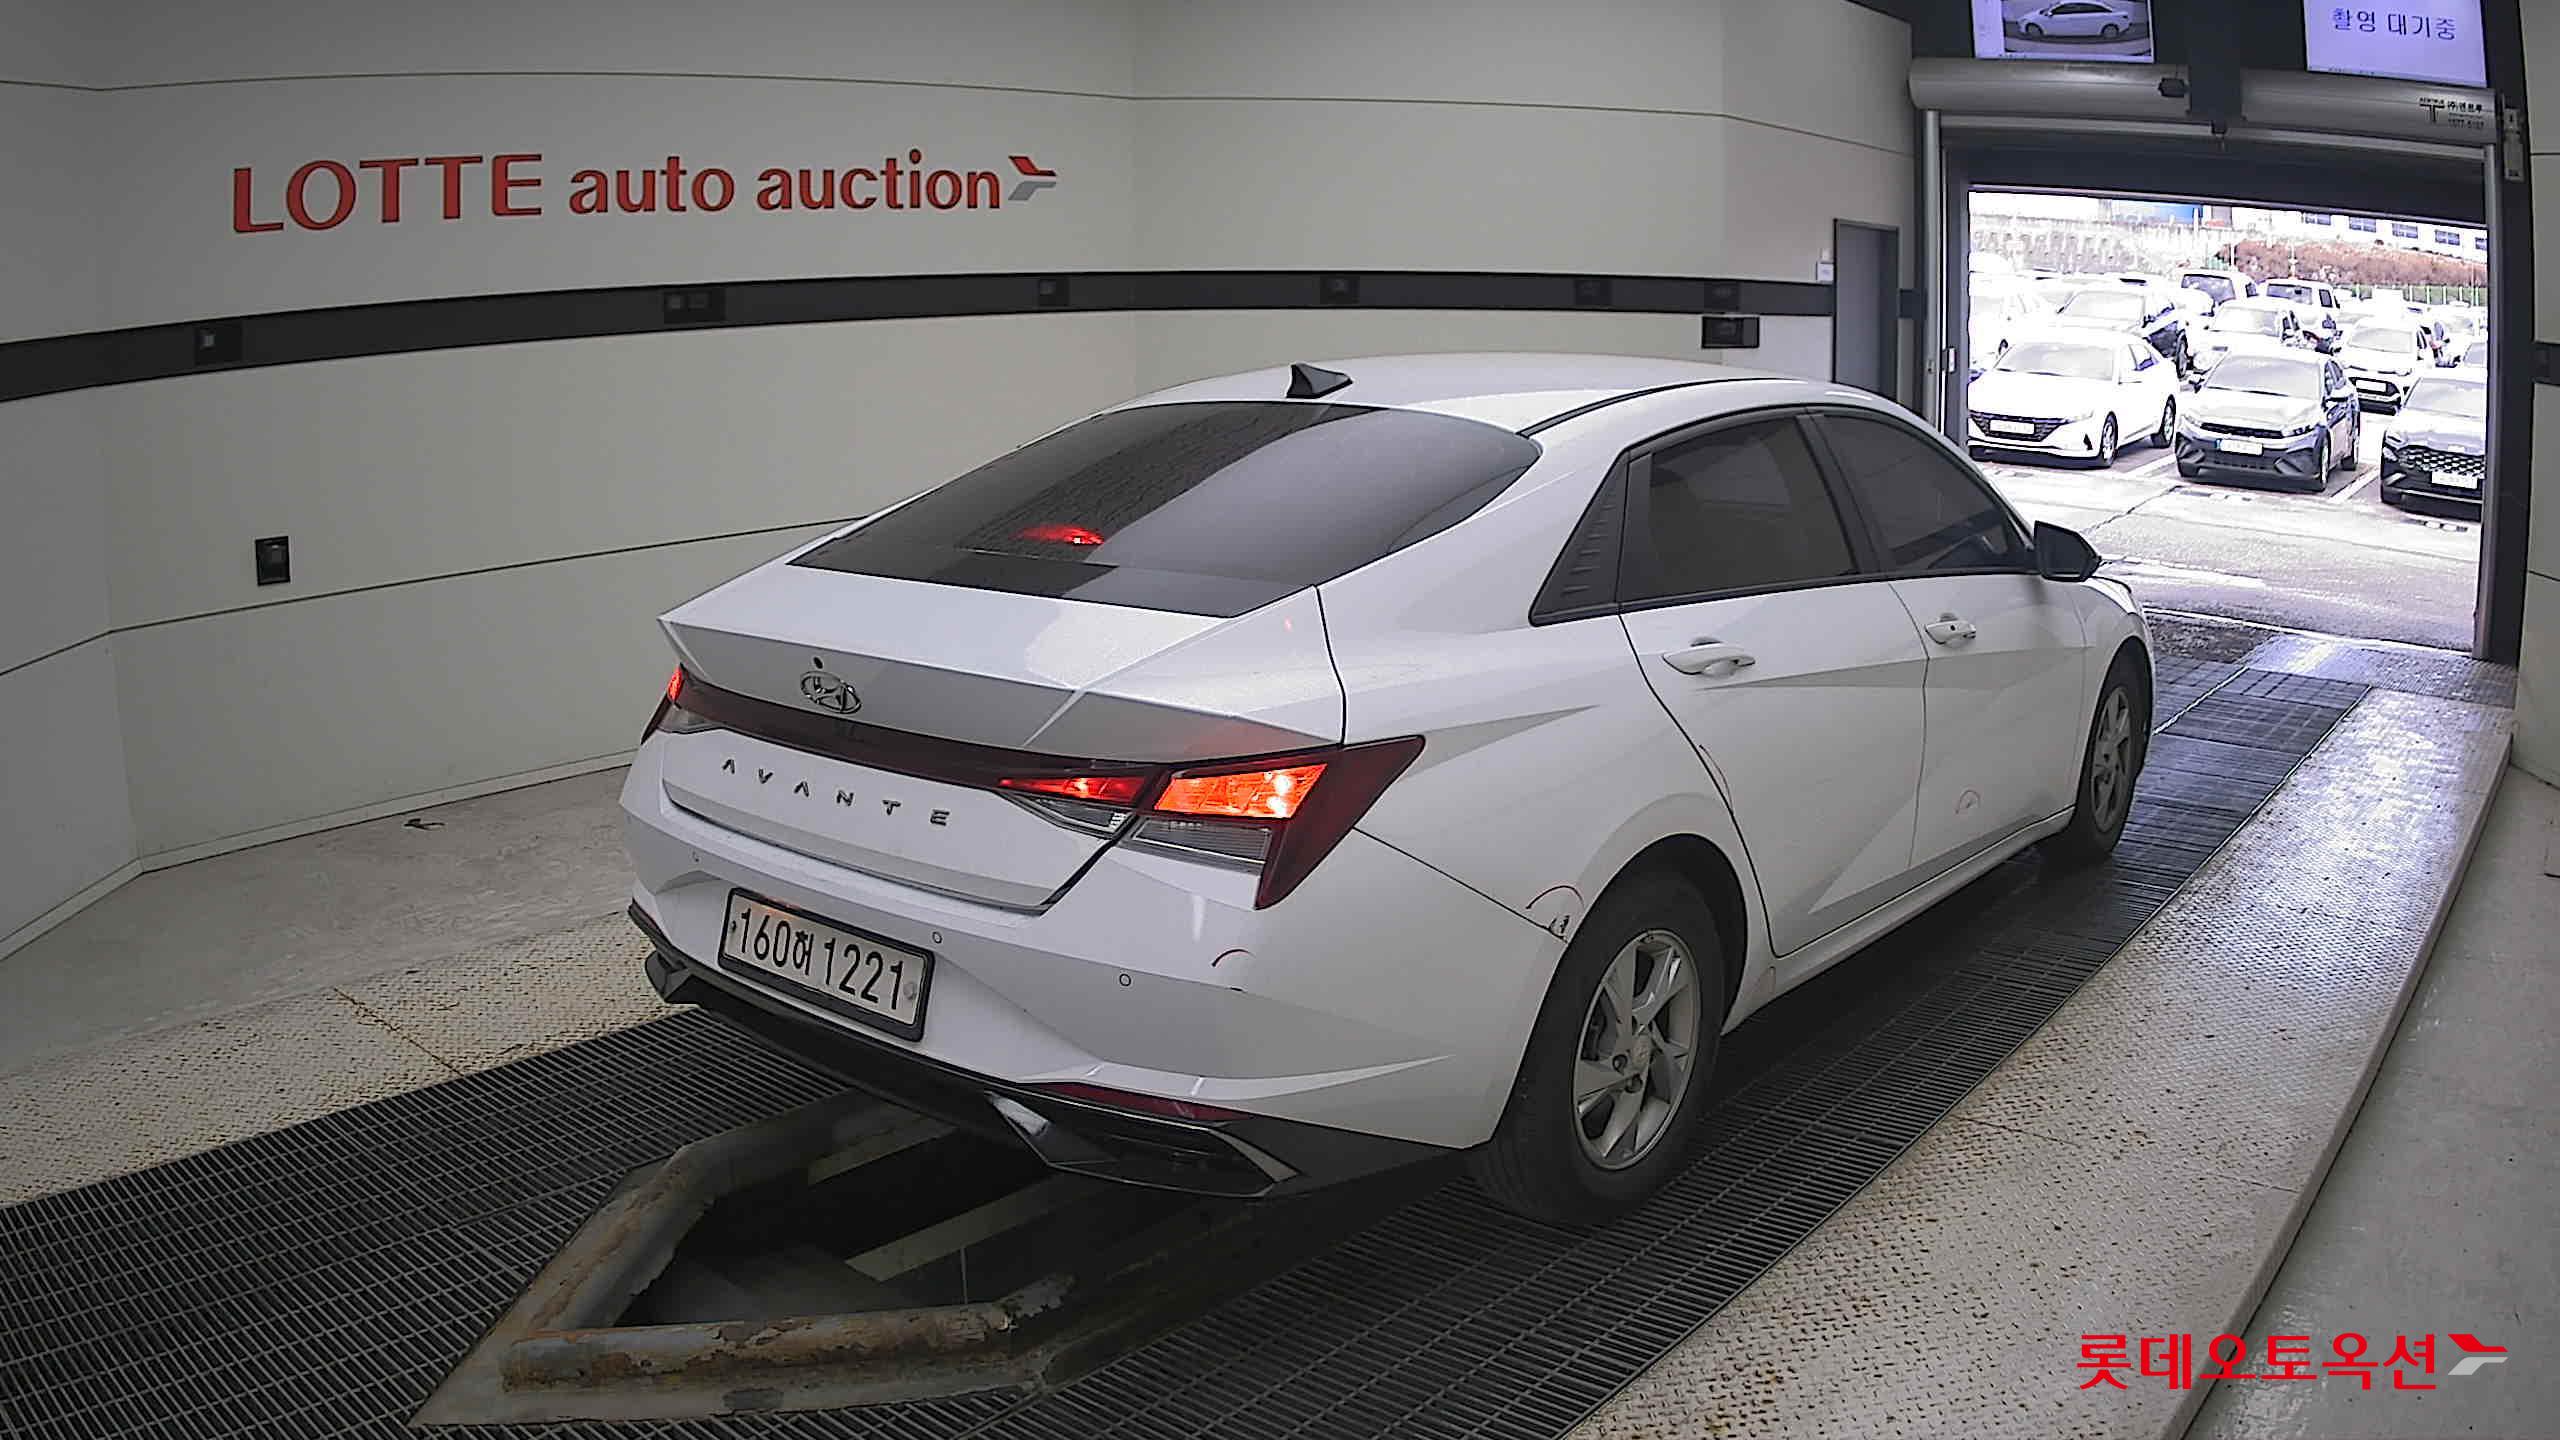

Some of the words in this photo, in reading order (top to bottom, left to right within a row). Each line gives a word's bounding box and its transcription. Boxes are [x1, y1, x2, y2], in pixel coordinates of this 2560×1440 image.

[2333, 8, 2376, 32] 촬영
[2387, 13, 2456, 41] 대기중
[233, 153, 543, 234] LOTTE
[568, 154, 735, 214] auto
[756, 148, 1001, 211] auction
[722, 758, 950, 827] AVANTE
[741, 907, 815, 977] 160허
[824, 937, 903, 1010] 1221
